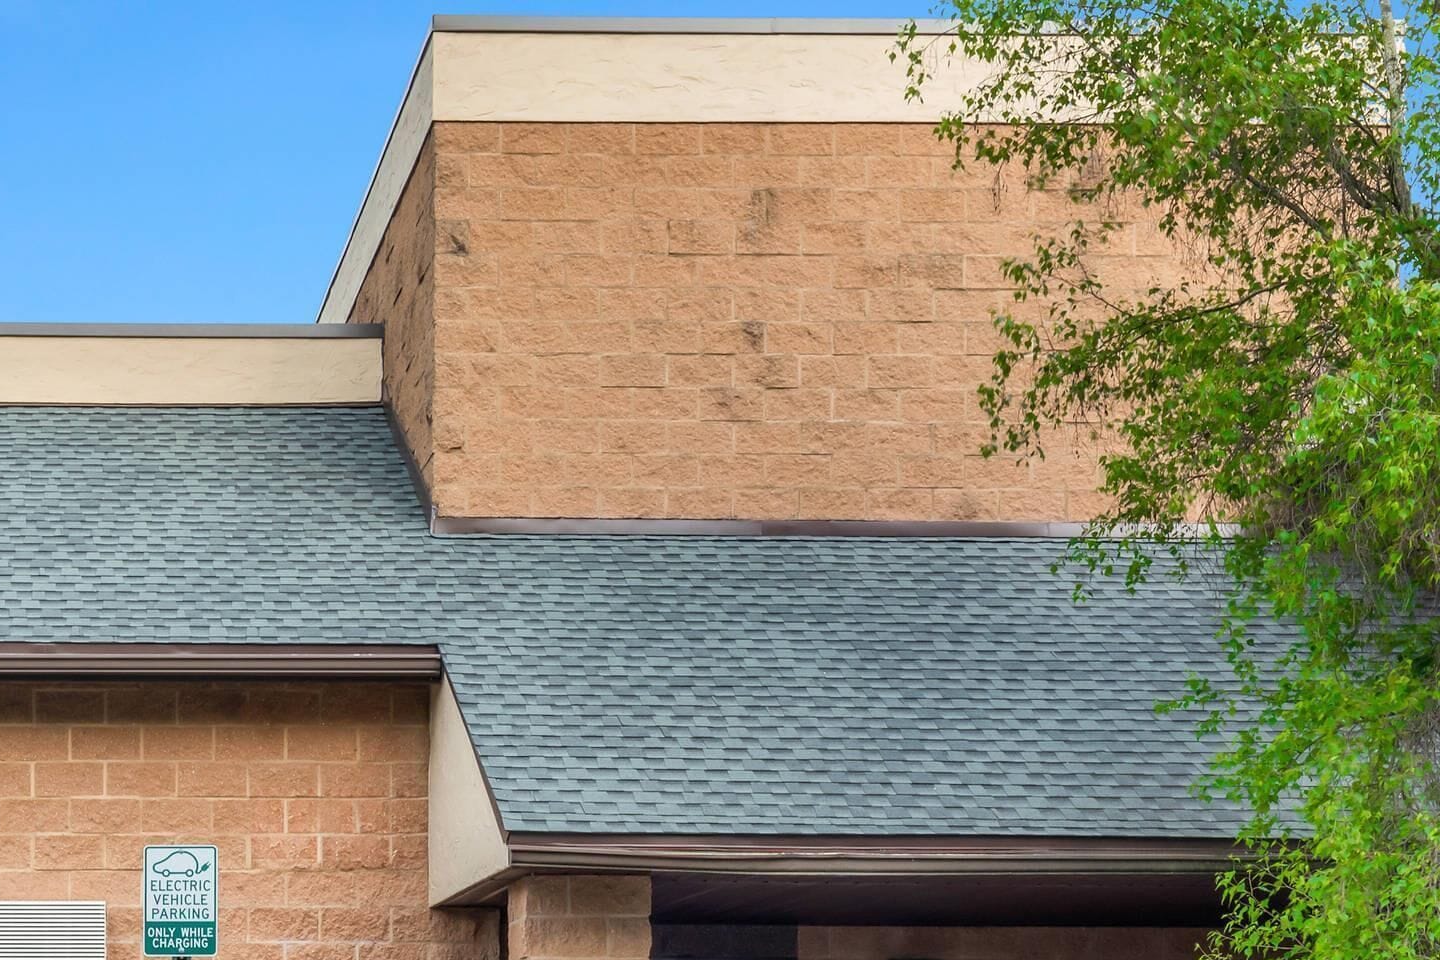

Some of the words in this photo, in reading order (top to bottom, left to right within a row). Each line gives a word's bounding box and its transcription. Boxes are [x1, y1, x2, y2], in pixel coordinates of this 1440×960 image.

[150, 880, 211, 892] ELECTRIC
[153, 894, 208, 905] VEHICLE
[151, 908, 210, 920] PARKING
[147, 927, 176, 938] ONLY
[181, 927, 214, 938] WHILE
[152, 938, 209, 949] CHARGING
